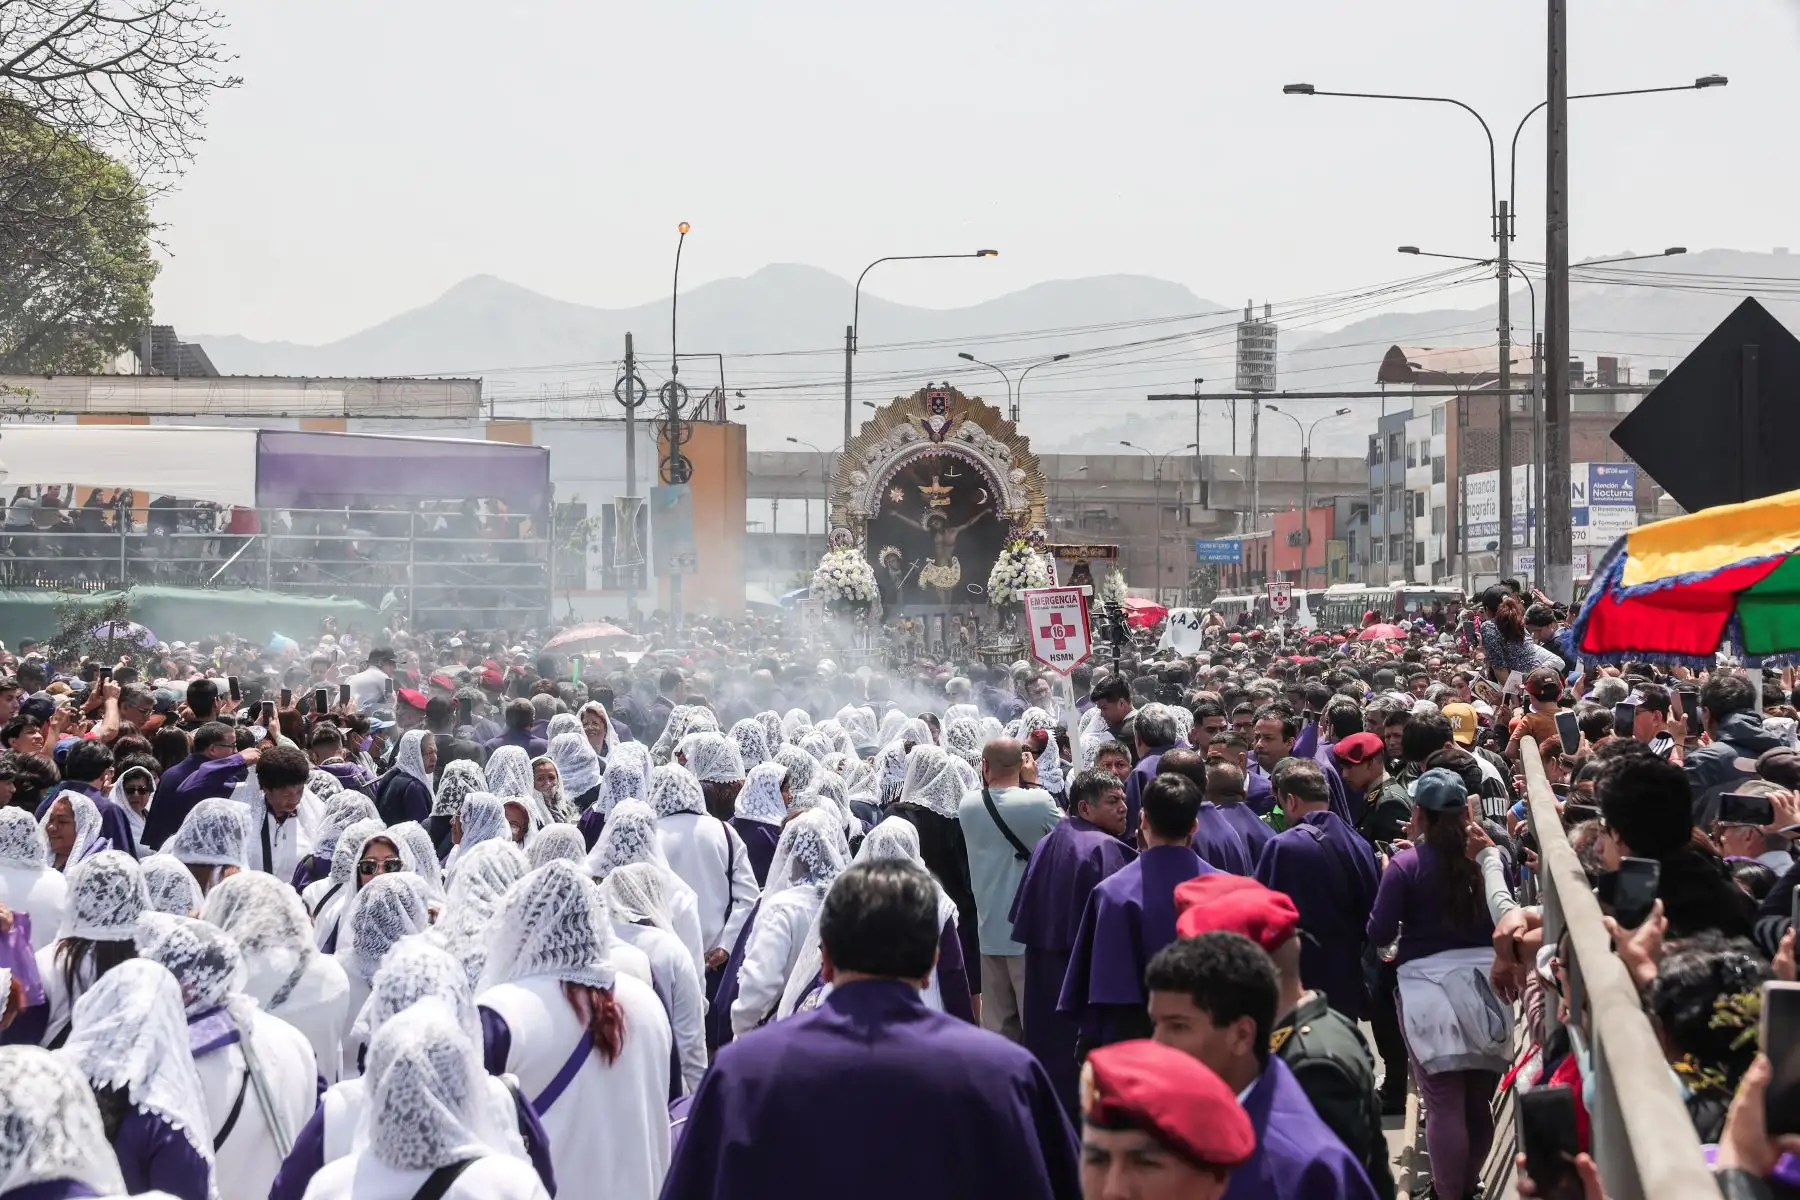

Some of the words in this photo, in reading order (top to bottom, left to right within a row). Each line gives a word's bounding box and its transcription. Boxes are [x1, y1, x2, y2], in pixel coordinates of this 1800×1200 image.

[1592, 489, 1633, 497] Nocturna
[1030, 594, 1078, 606] EMERGENCIA
[1053, 626, 1063, 637] 16
[1050, 653, 1074, 661] HSMN
